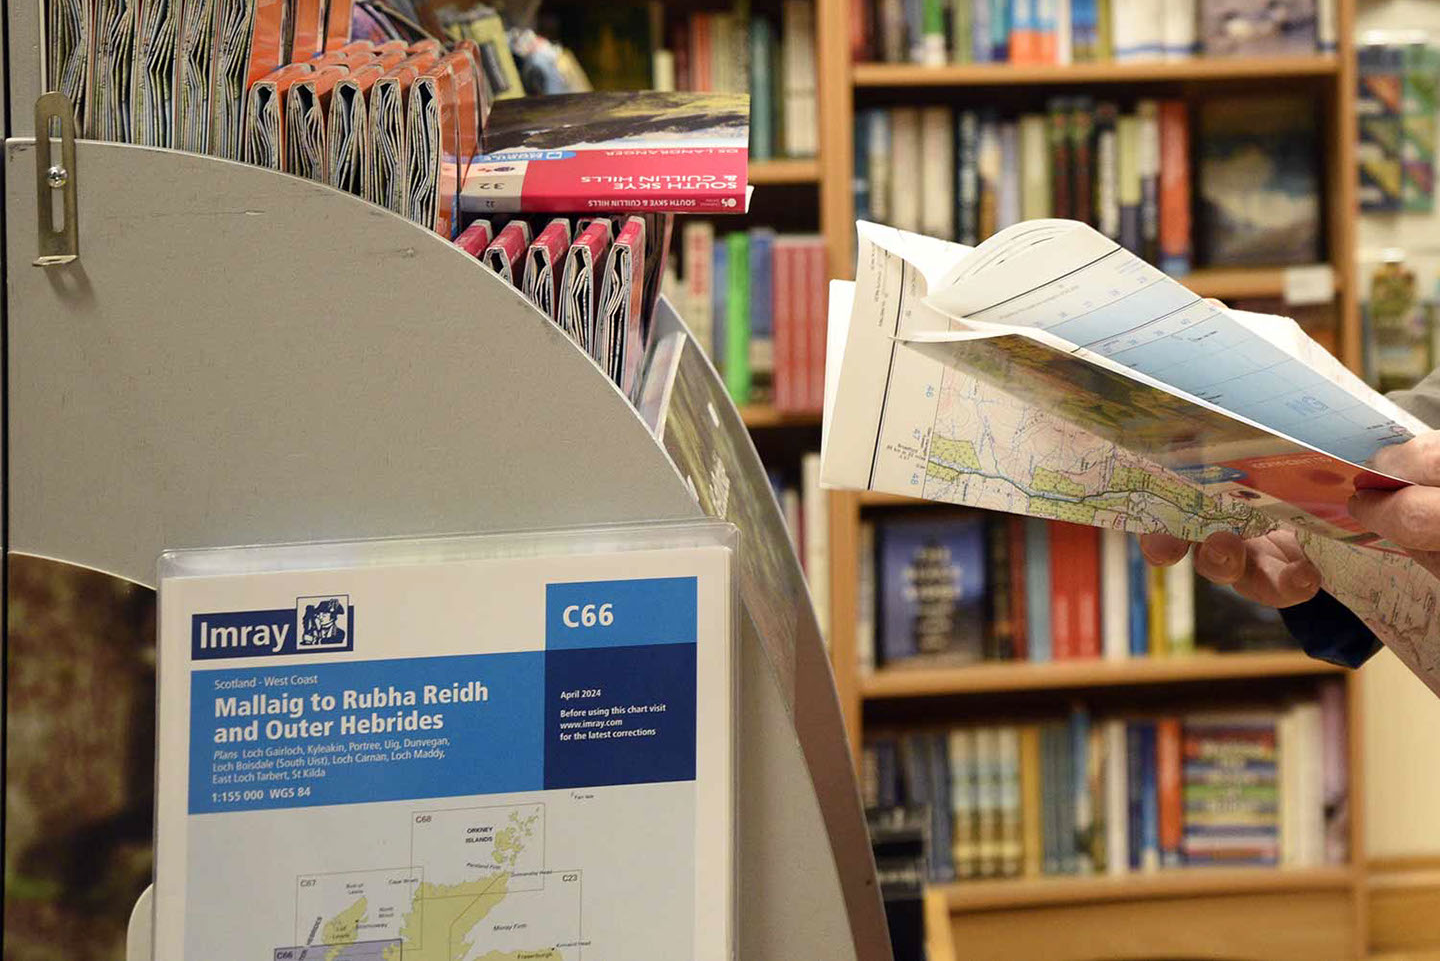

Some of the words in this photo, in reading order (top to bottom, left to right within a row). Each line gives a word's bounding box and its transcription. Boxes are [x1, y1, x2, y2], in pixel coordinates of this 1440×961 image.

[581, 175, 633, 183] HILLS
[635, 175, 721, 183] CUILLIN
[479, 182, 505, 190] 32
[614, 182, 667, 190] SKYE
[669, 182, 738, 190] SOUTH
[588, 199, 610, 207] HILLS
[611, 199, 642, 207] CUILLIN
[650, 199, 668, 207] SKYE
[669, 199, 696, 207] SOUTH
[562, 603, 615, 628] C66
[200, 621, 291, 653] Imray
[214, 678, 257, 690] Scotland
[264, 676, 288, 687] West
[290, 675, 319, 686] Coast
[214, 693, 304, 719] Mallaig
[310, 694, 335, 713] to
[343, 687, 416, 710] Rubha
[423, 681, 489, 705] Reidh
[560, 689, 580, 701] April
[581, 689, 602, 699] 2024
[560, 709, 586, 718] Before
[588, 707, 610, 718] using
[611, 705, 626, 715] this
[628, 705, 648, 715] chart
[649, 704, 667, 713] visit
[214, 720, 259, 743] and
[265, 719, 334, 741] Outer
[340, 712, 444, 735] Hebrides
[560, 719, 623, 730] www.imray.com
[560, 732, 573, 741] for
[574, 731, 587, 741] the
[588, 730, 611, 740] latest
[613, 727, 656, 738] corrections
[214, 750, 238, 760] Plans
[242, 748, 264, 758] Loch
[265, 746, 305, 757] Gairloch,
[307, 743, 347, 755] Kyleakin,
[349, 741, 382, 751] Portree,
[384, 740, 402, 751] Uig,
[403, 737, 451, 748] Dunvegan,
[212, 761, 234, 772] Loch
[236, 759, 274, 771] Boisdale
[276, 758, 305, 769] (South
[332, 753, 354, 764] Loch
[391, 750, 412, 761] Loch
[413, 748, 446, 760] Maddy,
[212, 774, 232, 784] East
[234, 773, 255, 783] Loch
[303, 768, 326, 778] Kilda
[211, 791, 241, 803] 1:155
[244, 790, 265, 800] 000
[269, 788, 295, 799] WGS
[297, 786, 312, 797] 84
[466, 826, 494, 834] ORKNEY
[465, 836, 493, 844] ISLANDS
